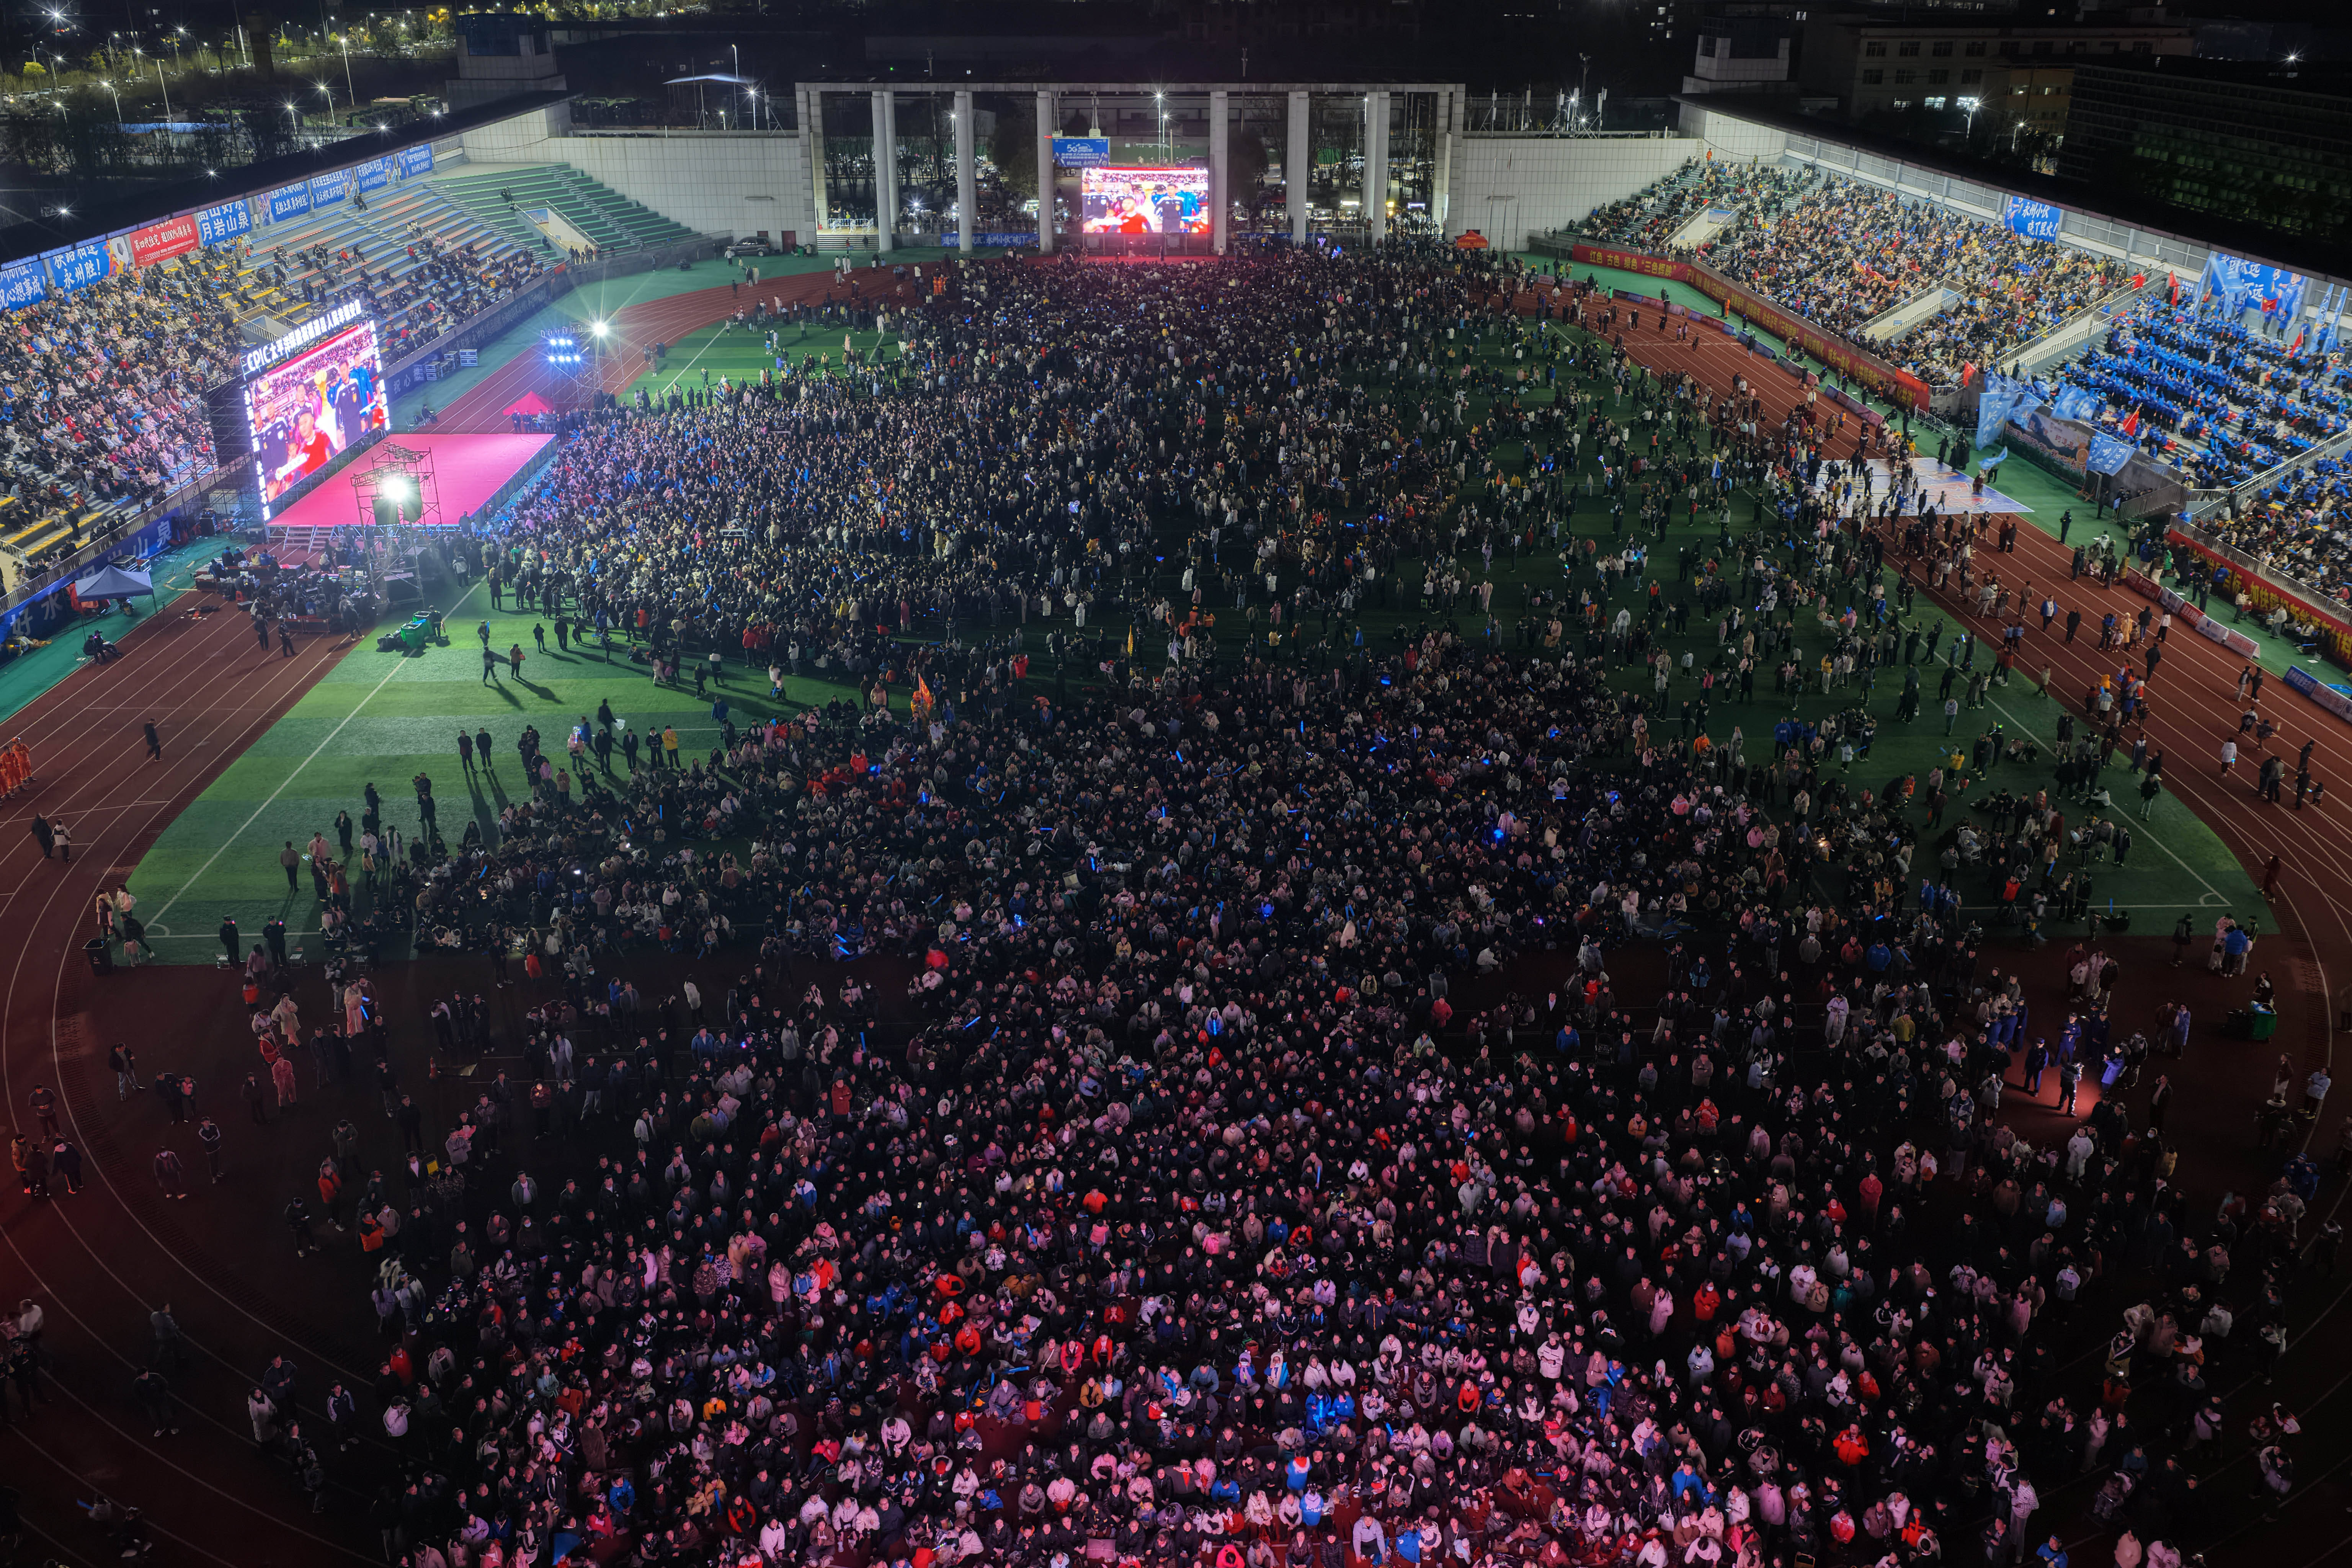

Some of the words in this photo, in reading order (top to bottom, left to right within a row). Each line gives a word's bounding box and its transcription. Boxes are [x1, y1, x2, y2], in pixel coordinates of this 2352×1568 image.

[1067, 144, 1077, 152] 5G
[2022, 202, 2050, 219] 永州小伙
[134, 234, 160, 252] 第四代住宅
[161, 224, 192, 243] 超100%得房率
[202, 211, 249, 241] 月岩山泉
[64, 258, 100, 290] 永州胜！
[1590, 250, 1603, 264] 红色
[1607, 253, 1620, 267] 古色
[1624, 257, 1637, 270] 绿色
[1642, 260, 1676, 277] “三色辉映”
[0, 275, 46, 307] 祝心想事成！
[1828, 346, 1850, 372] 城乡一体化
[11, 591, 63, 637] 好水
